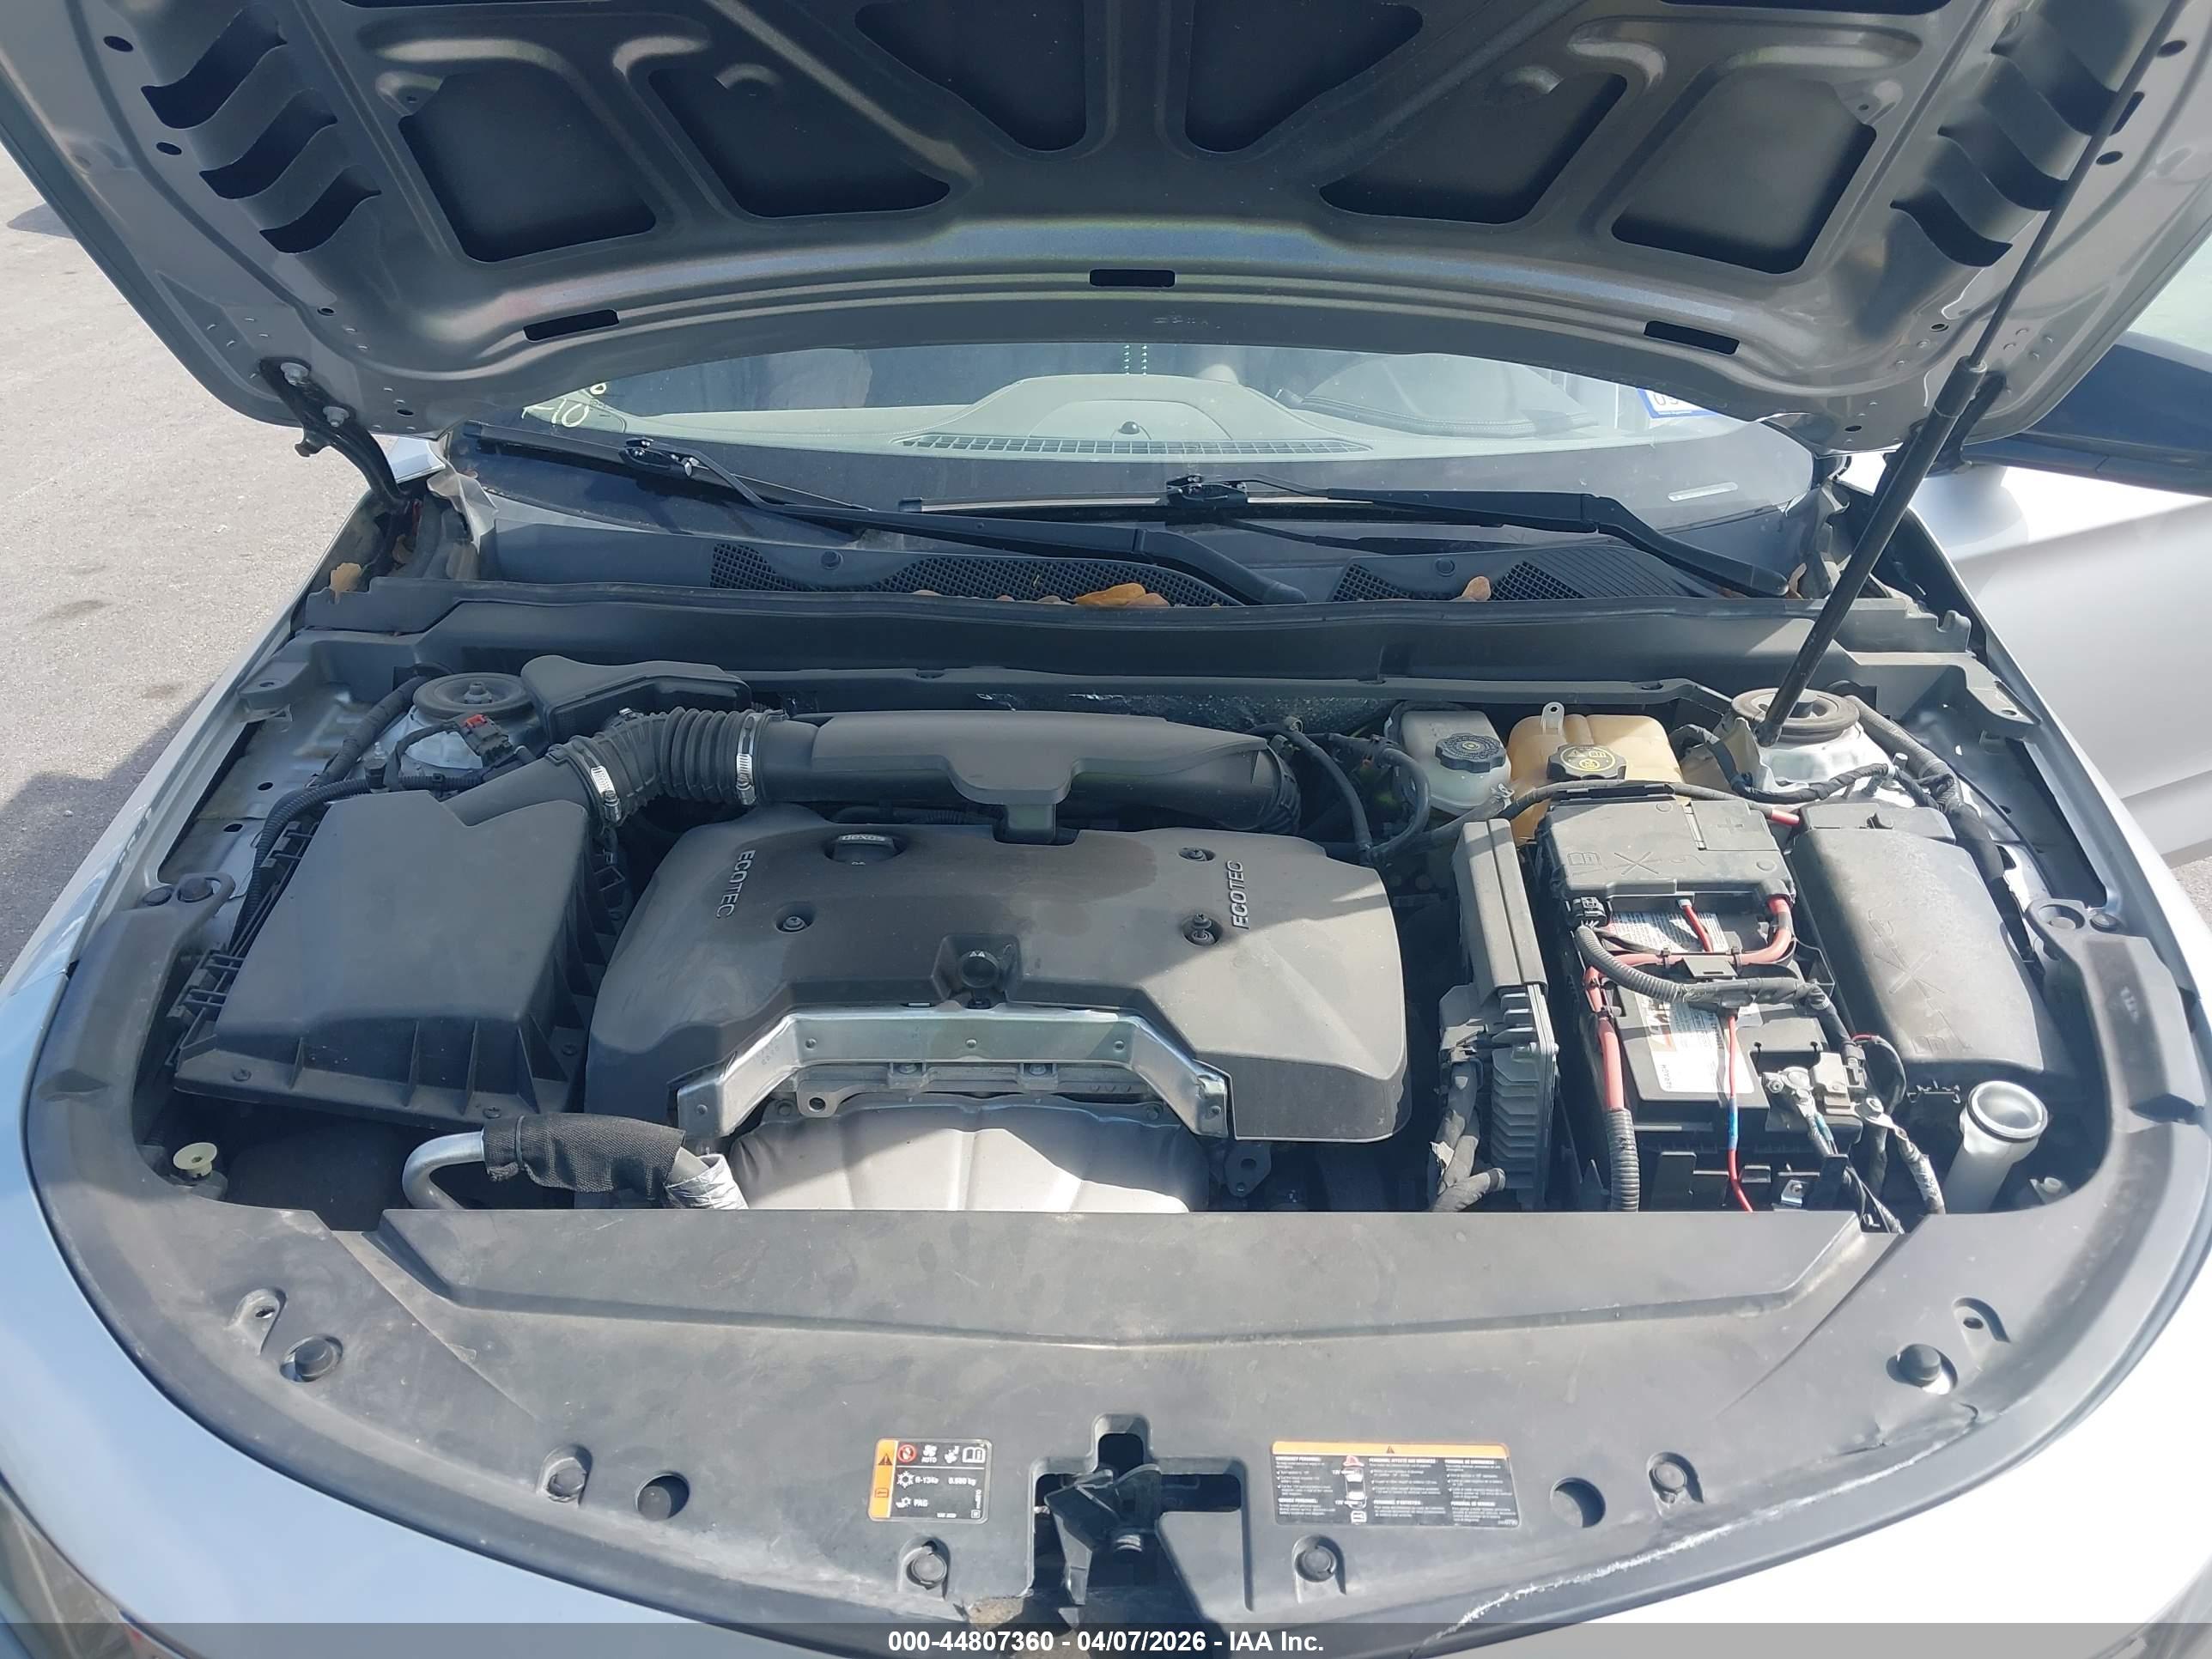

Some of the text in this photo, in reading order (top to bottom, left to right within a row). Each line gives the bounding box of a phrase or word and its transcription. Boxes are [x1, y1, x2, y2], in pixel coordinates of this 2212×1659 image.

[716, 849, 756, 919] ECOTEC
[1226, 860, 1250, 930] ECOTEC
[913, 1498, 929, 1507] PAG
